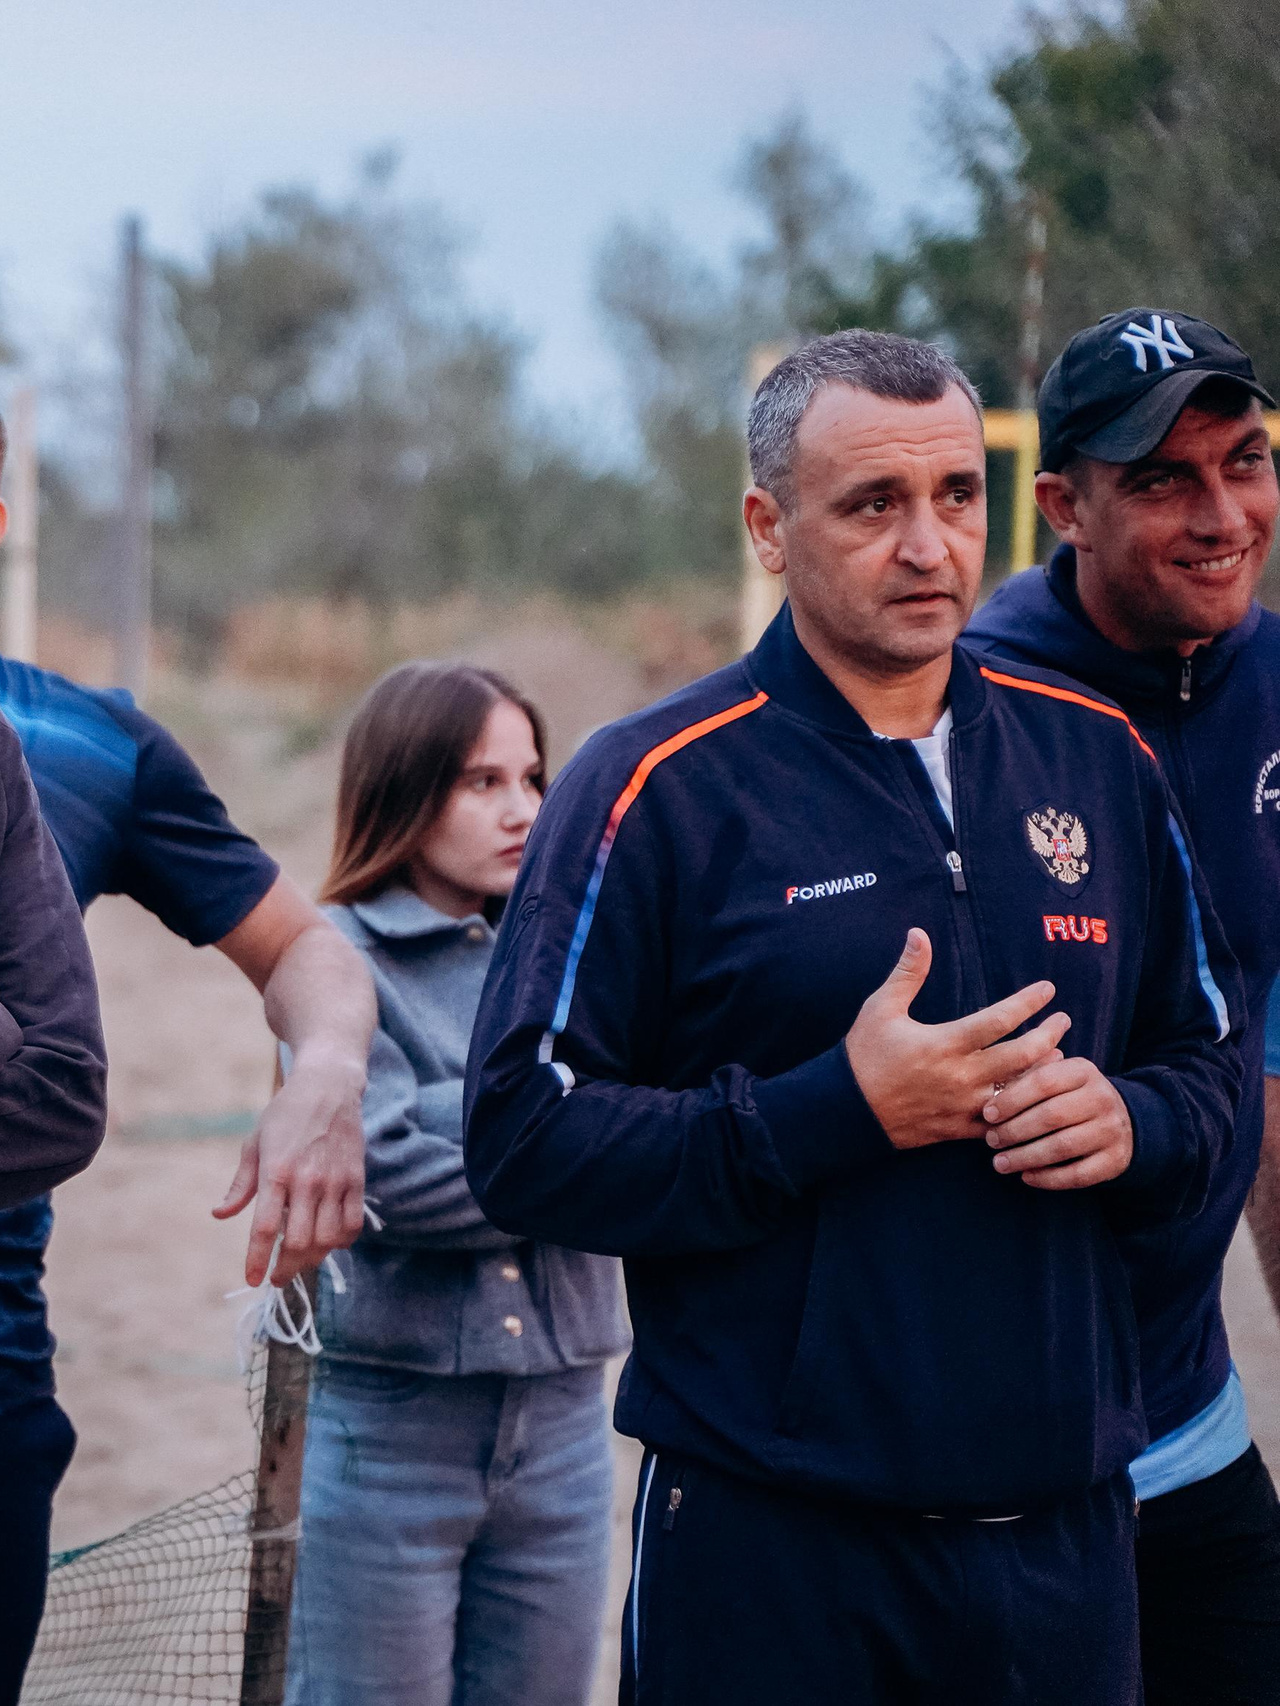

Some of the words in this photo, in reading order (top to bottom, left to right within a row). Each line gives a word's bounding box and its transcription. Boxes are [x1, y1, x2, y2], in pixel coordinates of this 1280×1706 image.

[1120, 314, 1194, 373] NY
[1254, 749, 1280, 814] КРИСТАЛ
[1263, 788, 1280, 801] ВОР
[786, 872, 878, 905] FORWARD
[1043, 914, 1108, 944] RUS
